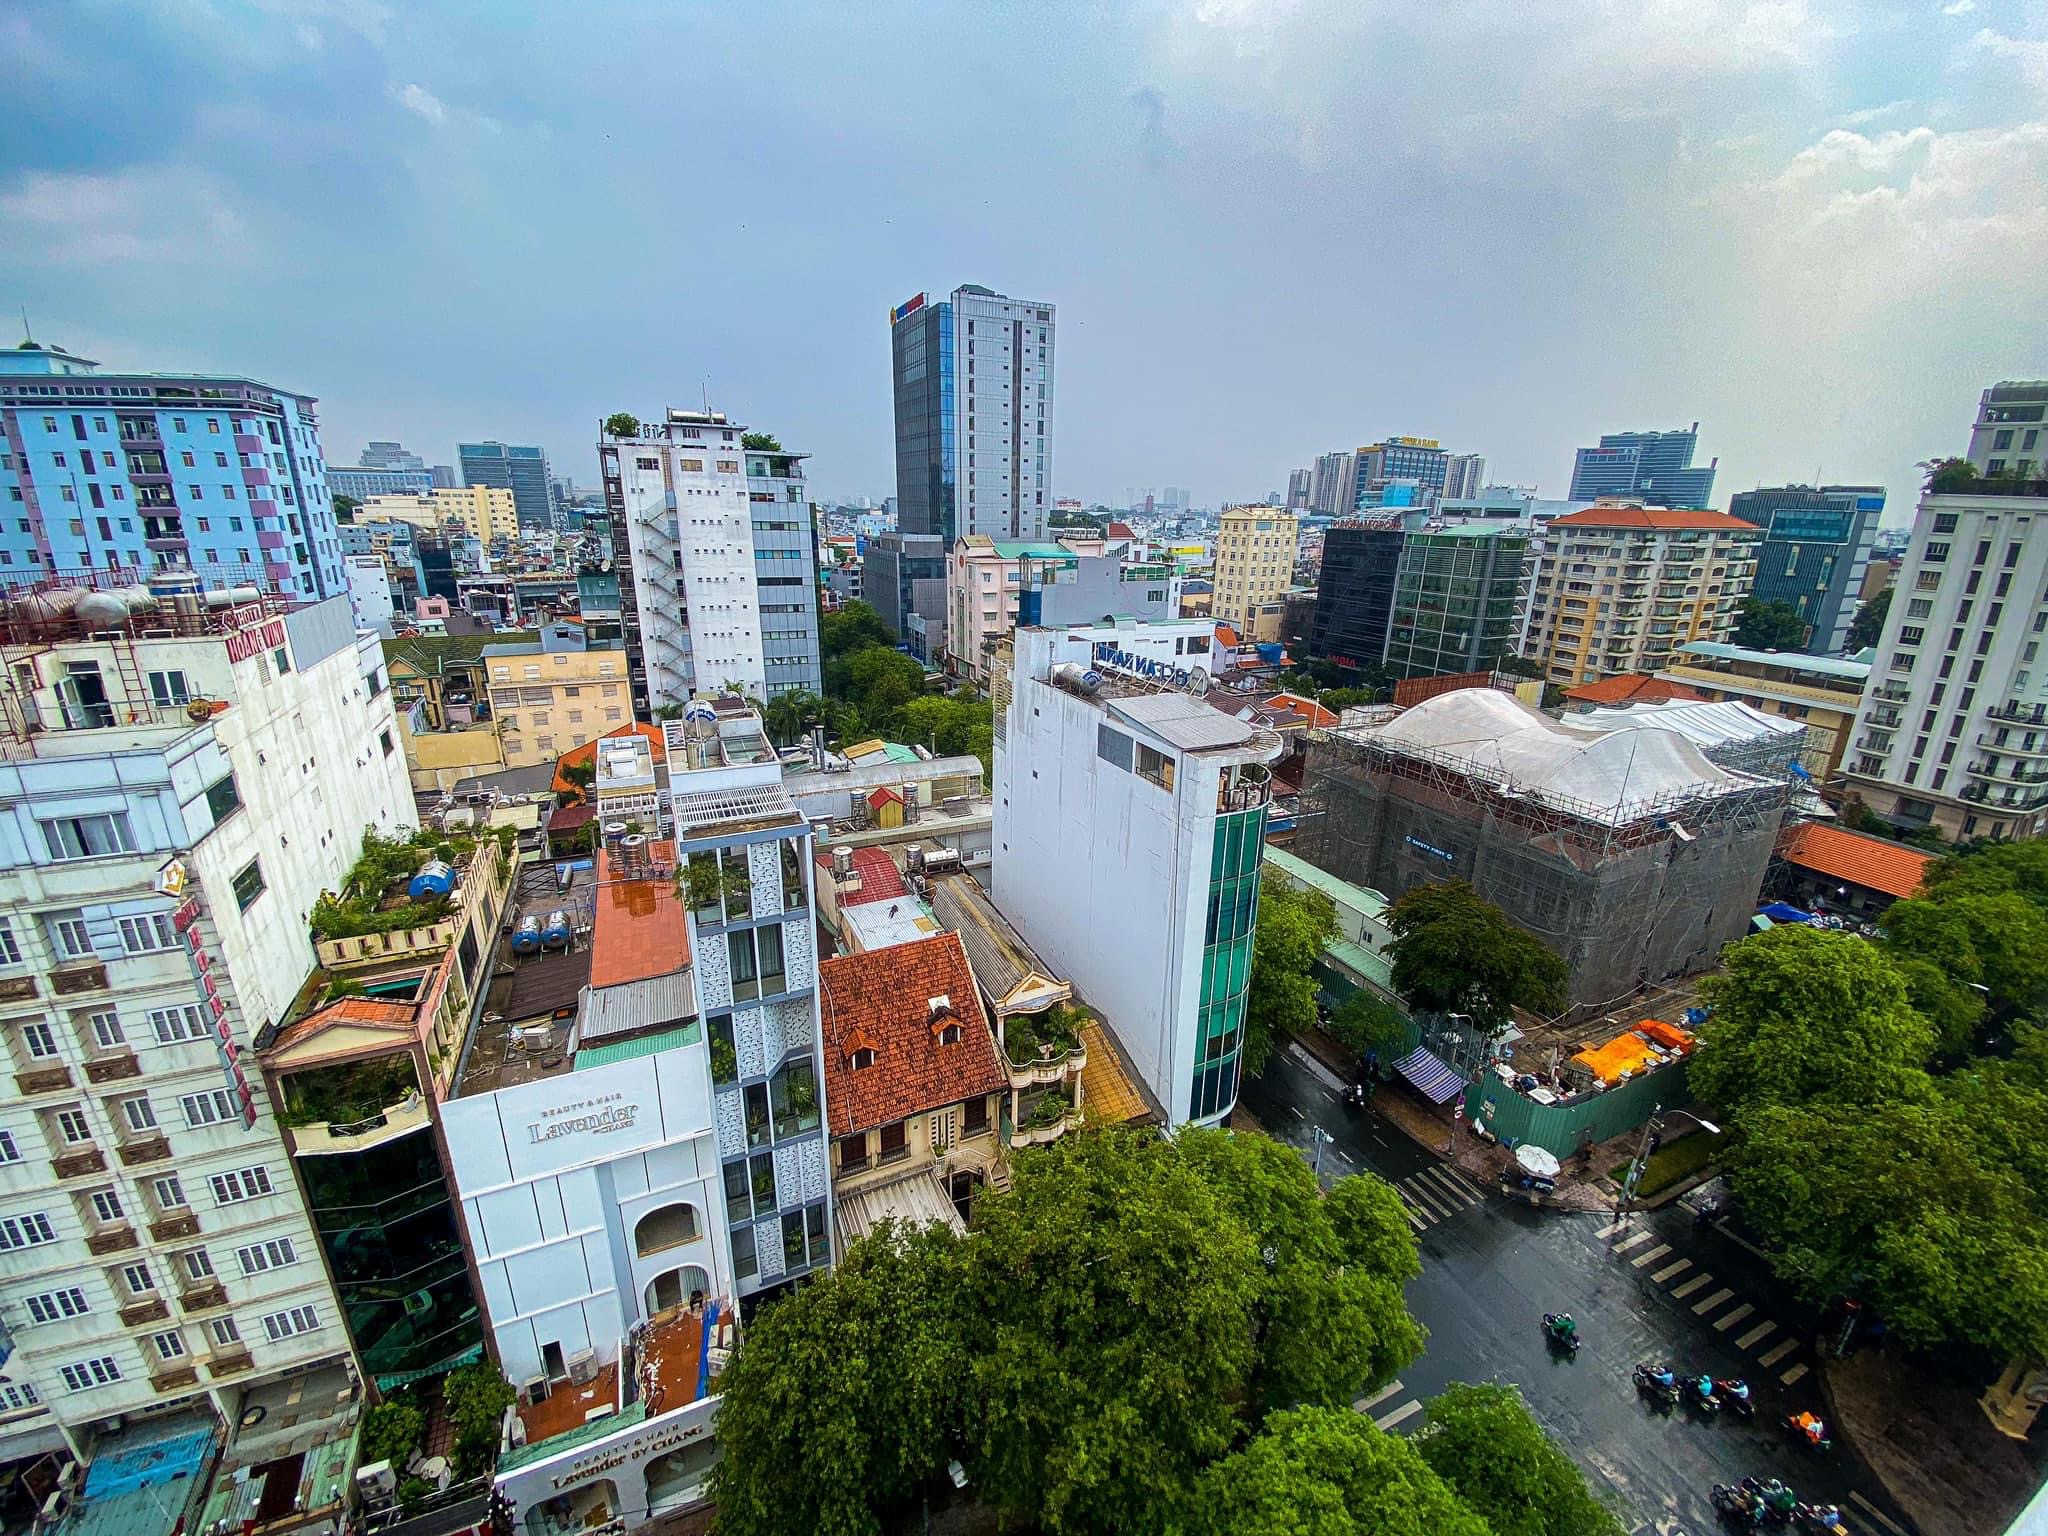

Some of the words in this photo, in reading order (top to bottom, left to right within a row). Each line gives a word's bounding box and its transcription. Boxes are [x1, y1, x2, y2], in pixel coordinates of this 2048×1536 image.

[528, 1104, 639, 1145] Lavender
[541, 1101, 585, 1118] BEAUTY
[596, 1092, 622, 1105] HAIR
[551, 1454, 627, 1490] Lavender
[652, 1424, 704, 1451] CHANG
[574, 1442, 630, 1469] BEAUTY
[646, 1423, 679, 1441] HAIR
